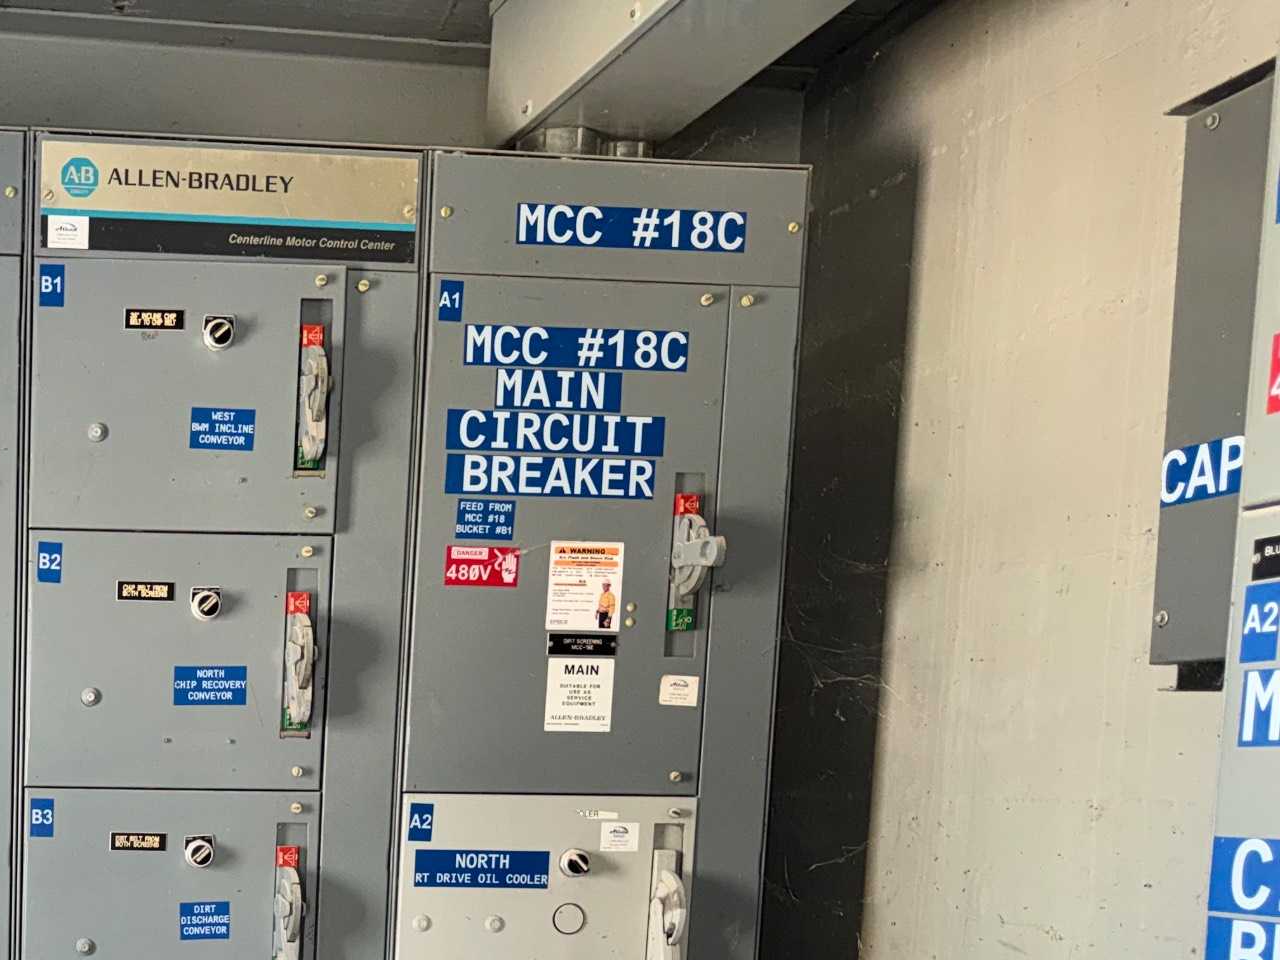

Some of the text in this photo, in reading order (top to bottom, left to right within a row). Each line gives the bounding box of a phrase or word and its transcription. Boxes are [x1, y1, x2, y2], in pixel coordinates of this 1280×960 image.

[64, 166, 94, 183] AB
[108, 168, 293, 193] ALLEN-BRADLEY
[518, 204, 744, 251] MCC #18C
[229, 233, 395, 251] Centerline Motor Control Center
[41, 277, 62, 293] B1
[439, 292, 460, 309] A1
[466, 325, 687, 370] MCC #18C
[496, 369, 606, 409] MAIN
[212, 412, 235, 421] WEST
[192, 423, 254, 433] BWM INCLINE
[459, 410, 652, 453] CIRCUIT
[199, 435, 245, 445] CONVEYOR
[462, 455, 653, 497] BREAKER
[1161, 436, 1244, 503] CAP
[460, 502, 512, 512] FEED FROM
[465, 514, 505, 523] MCC #18
[456, 525, 512, 535] BUCKET #B1
[39, 553, 61, 569] B2
[1244, 602, 1278, 634] A2
[197, 670, 224, 678] NORTH
[564, 664, 599, 675] MAIN
[174, 680, 246, 689] CHIP RECOVERY
[188, 691, 232, 700] CONVEYOR
[32, 809, 52, 824] B3
[409, 814, 432, 829] A2
[456, 853, 510, 869] NORTH
[415, 873, 548, 885] RT DRIVE OIL COOLER
[1231, 839, 1280, 911] C
[194, 905, 216, 913] DIRT
[181, 915, 230, 924] DISCHARGE
[183, 925, 227, 935] CONVEYOR
